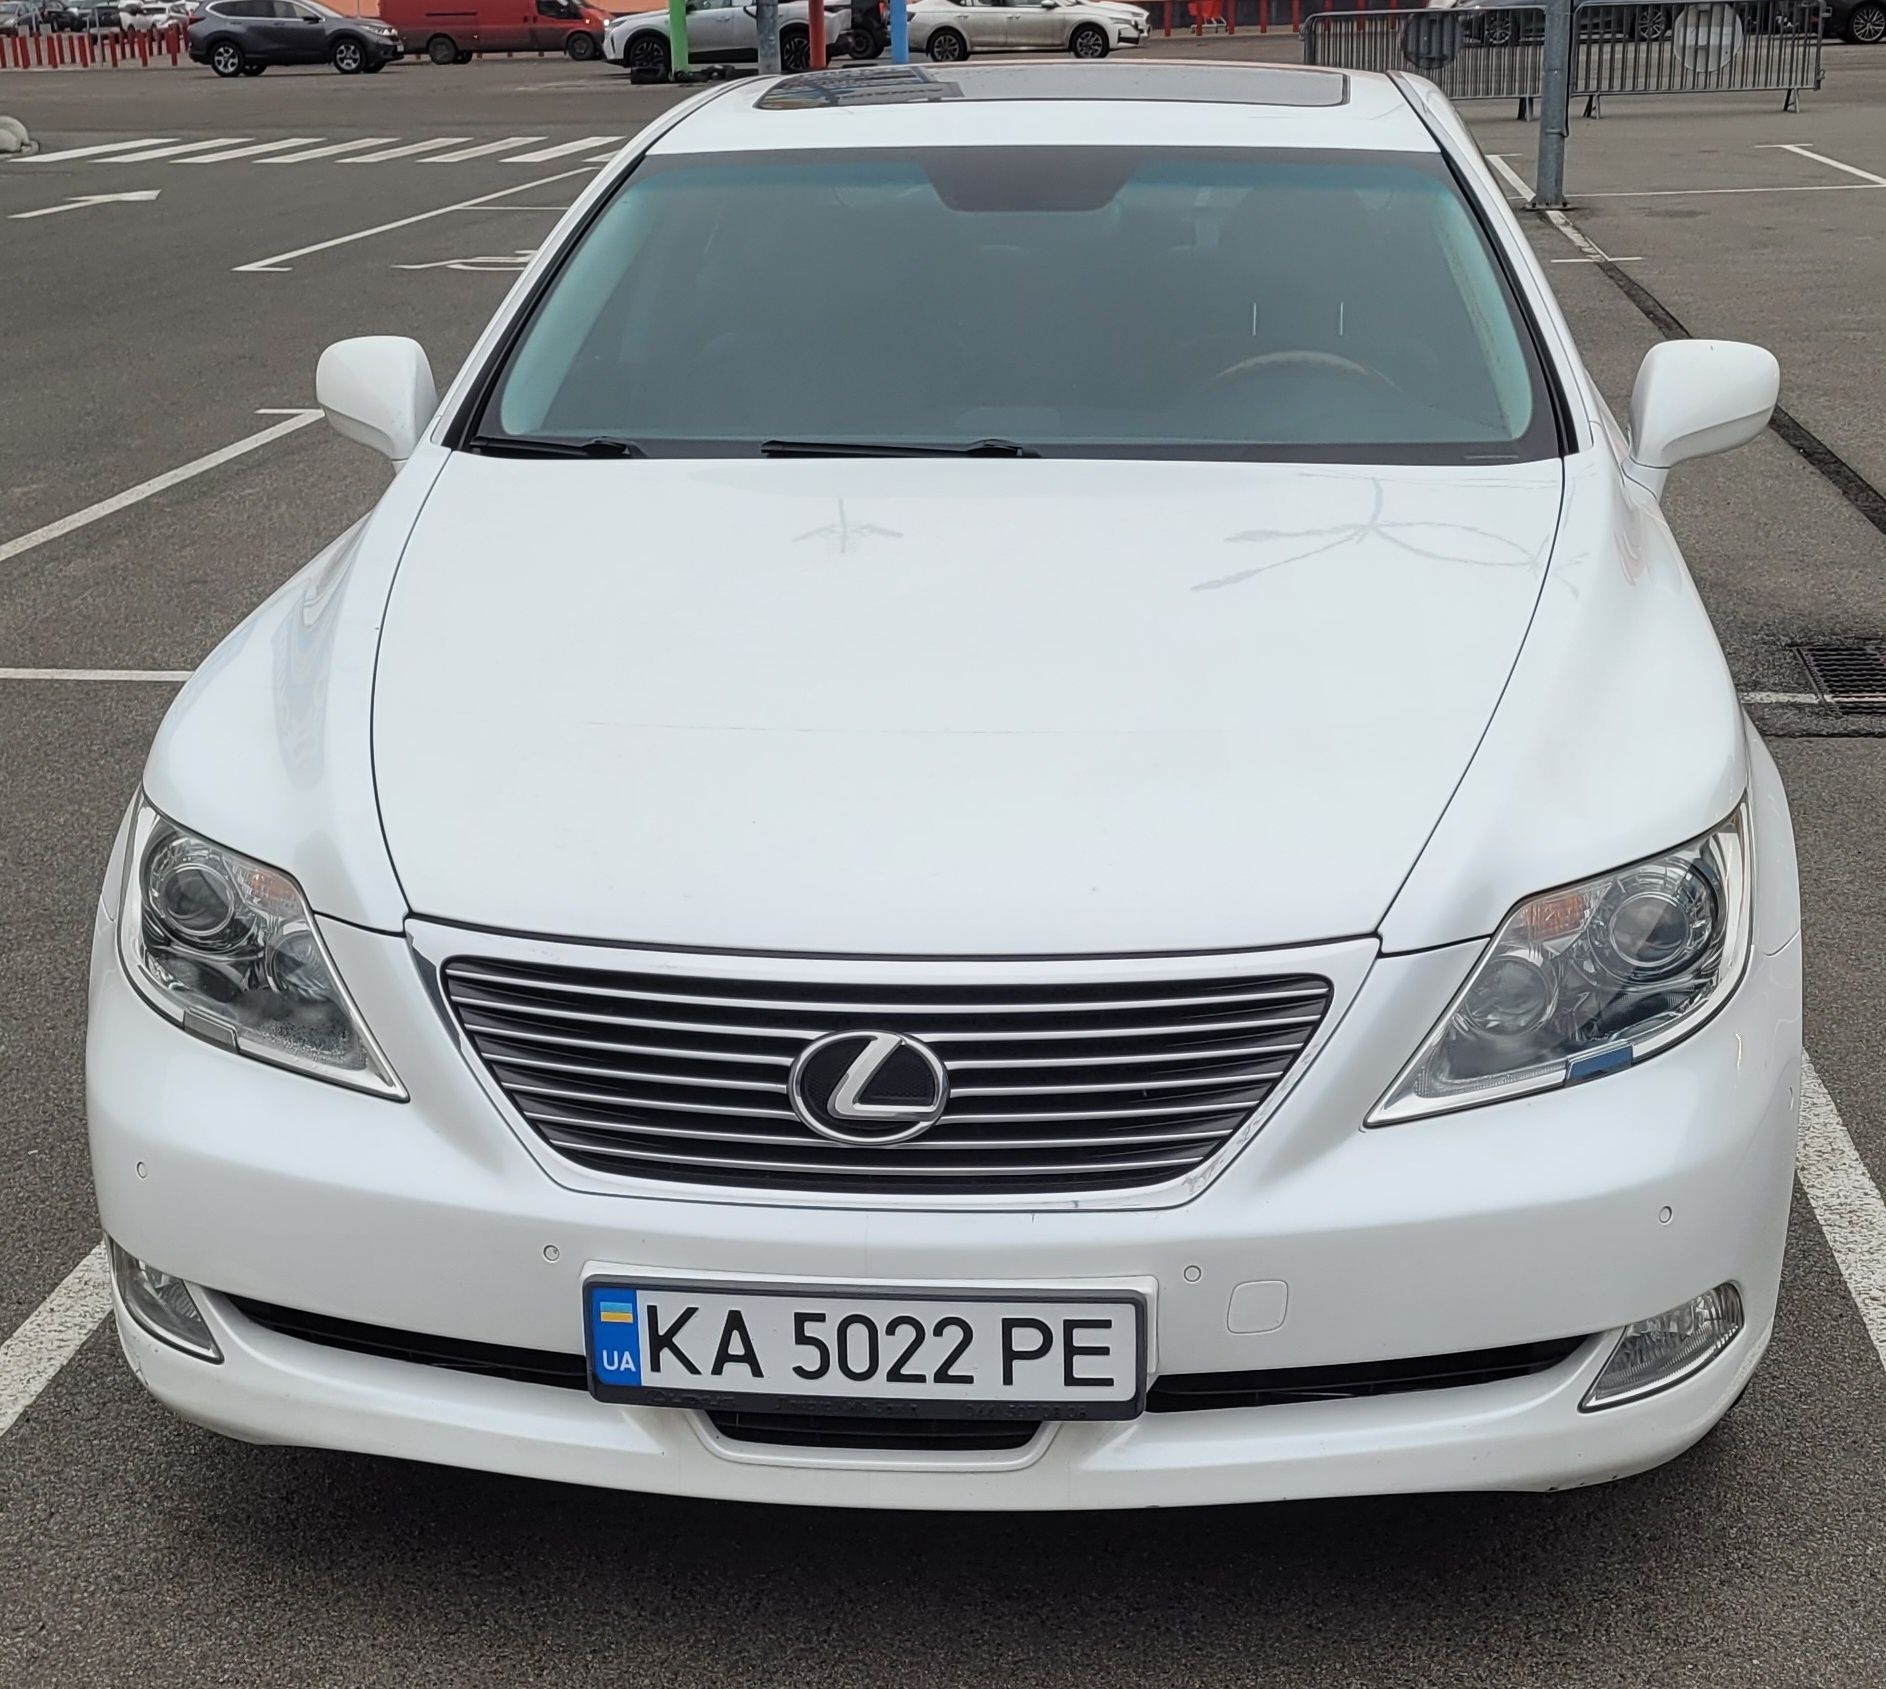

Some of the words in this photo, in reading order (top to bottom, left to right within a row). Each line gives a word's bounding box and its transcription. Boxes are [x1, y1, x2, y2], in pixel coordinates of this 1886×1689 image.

[602, 1349, 637, 1372] UA
[646, 1304, 765, 1378] KA
[792, 1311, 975, 1385] 5022
[1001, 1317, 1115, 1387] PE
